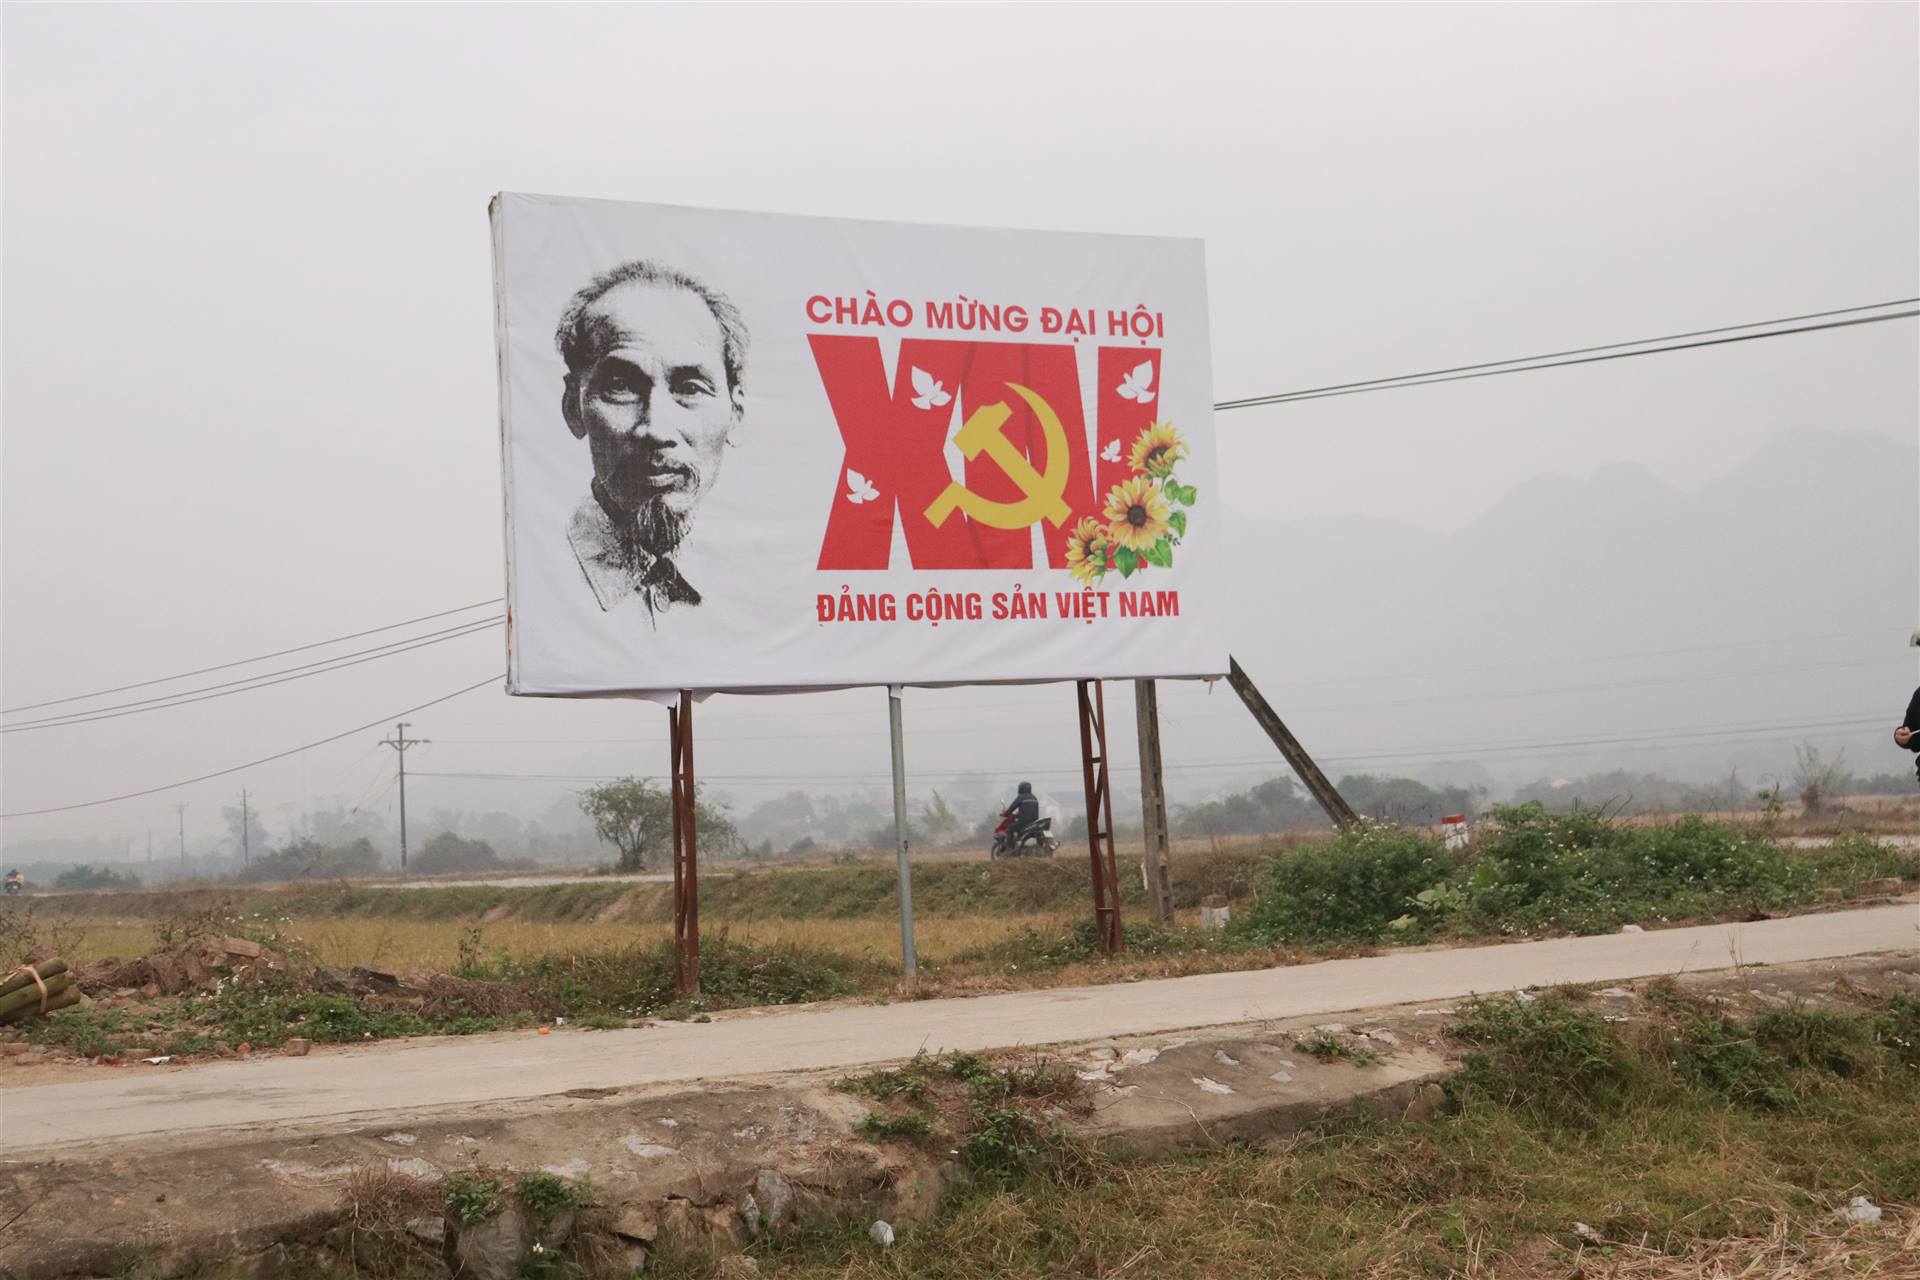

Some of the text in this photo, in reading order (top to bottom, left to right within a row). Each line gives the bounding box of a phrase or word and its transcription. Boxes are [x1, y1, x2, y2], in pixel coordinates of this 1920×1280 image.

[806, 290, 1163, 345] CHÀO MỪNG ĐẠI HỘI
[807, 334, 1161, 571] XIV
[816, 583, 1180, 627] ĐẢNG CỘNG SẢN VIỆT NAM
